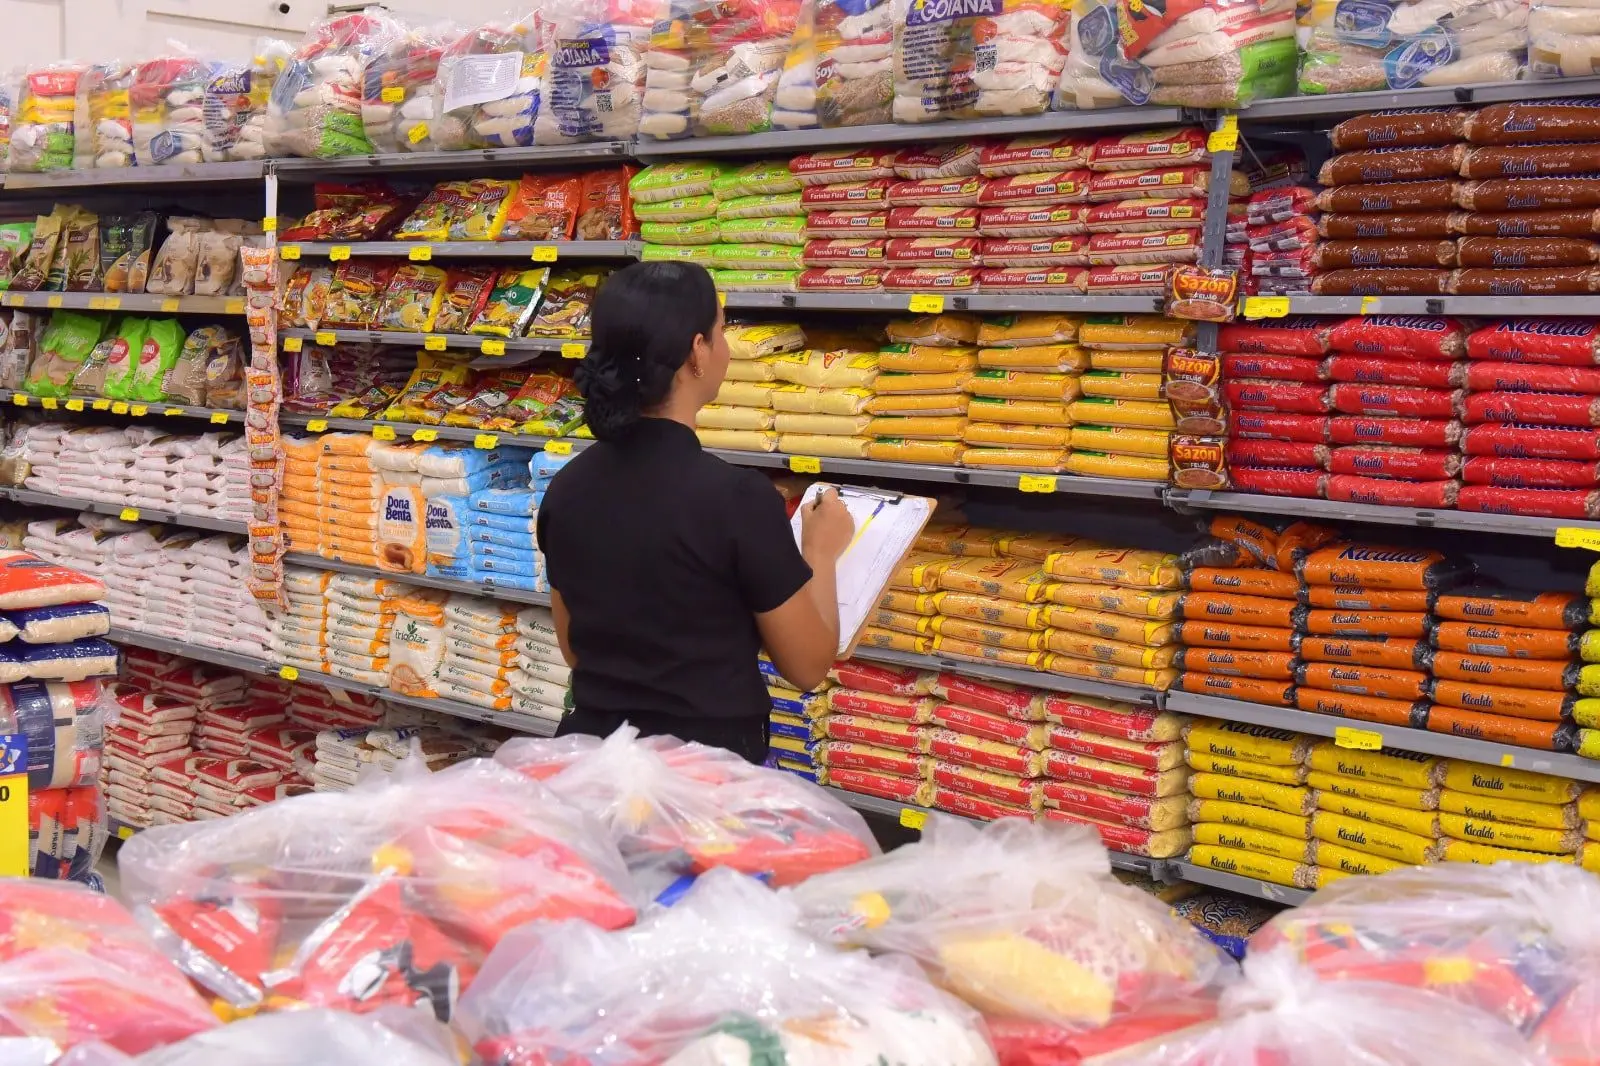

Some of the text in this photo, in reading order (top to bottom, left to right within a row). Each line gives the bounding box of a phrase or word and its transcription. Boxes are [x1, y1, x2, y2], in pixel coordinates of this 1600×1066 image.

[920, 0, 994, 22] GOIANA
[815, 62, 838, 79] Soy
[1101, 147, 1125, 155] Farinha
[1148, 144, 1169, 152] Uarini
[994, 189, 1016, 197] Farinha
[1036, 185, 1055, 193] Uarini
[1029, 212, 1048, 221] Uarini
[1147, 207, 1168, 216] Uarini
[1141, 272, 1162, 281] Uarini
[387, 496, 410, 510] Dona
[385, 508, 412, 522] Benta
[427, 504, 448, 518] Dona
[1462, 602, 1495, 617] Kicaldo
[1459, 659, 1492, 674] Kicaldo
[1461, 692, 1494, 709] Kicaldo
[1209, 742, 1237, 757] Kicaldo
[1337, 761, 1366, 777] Kicaldo
[1471, 774, 1504, 791] Kicaldo
[1337, 827, 1367, 845] Kicaldo
[1463, 822, 1495, 840] Kicaldo
[1218, 834, 1246, 849] Kicaldo
[1211, 855, 1238, 871] Kicaldo
